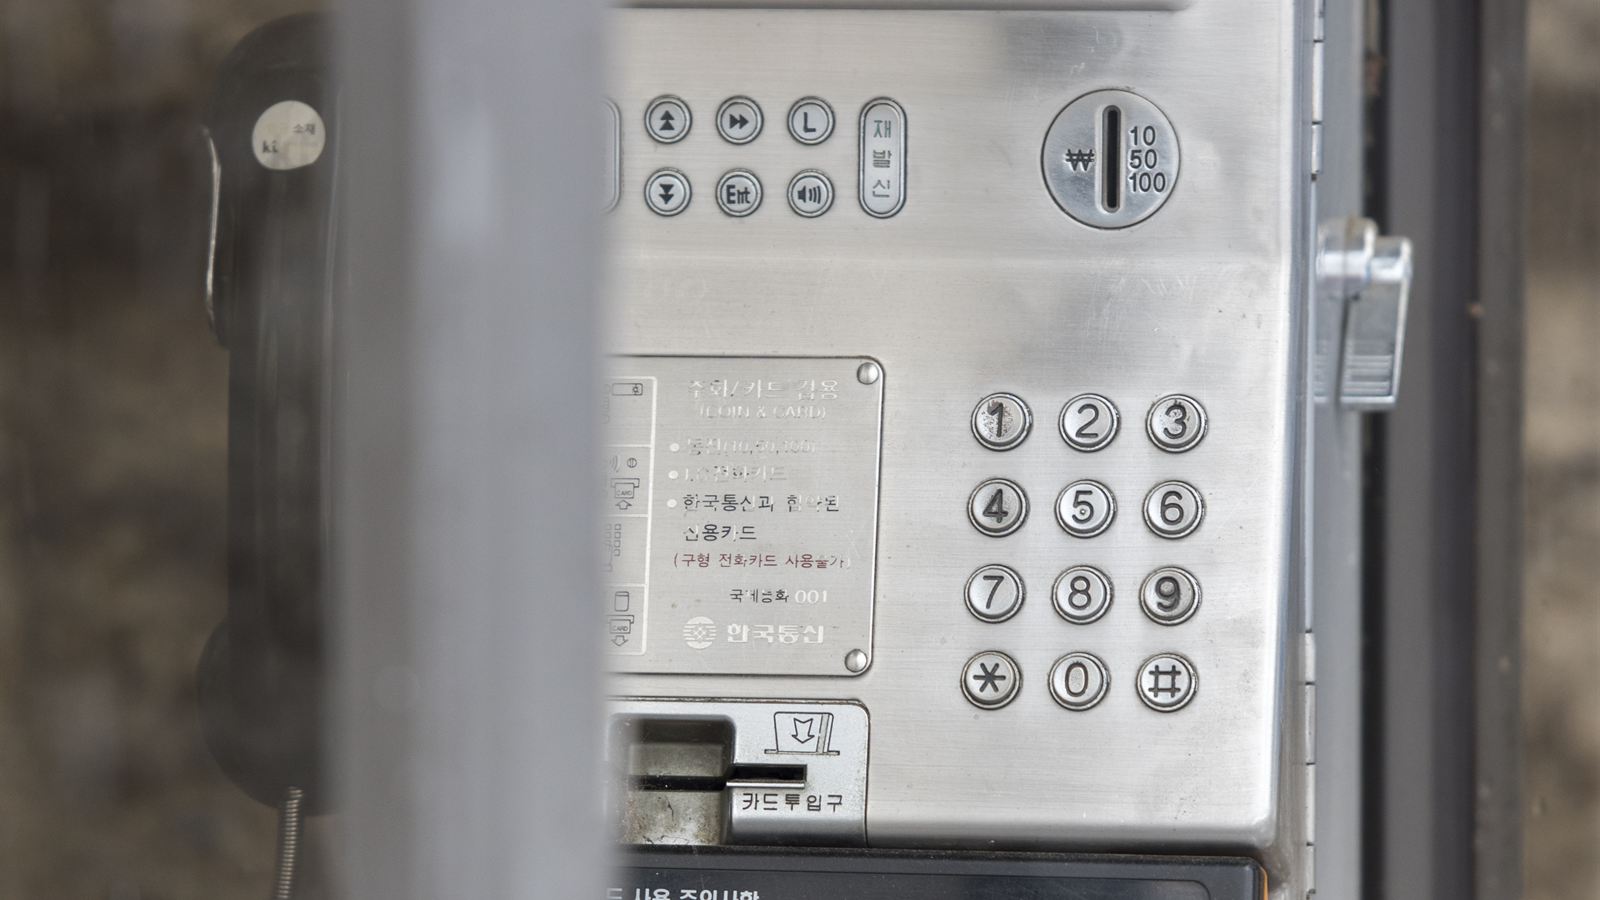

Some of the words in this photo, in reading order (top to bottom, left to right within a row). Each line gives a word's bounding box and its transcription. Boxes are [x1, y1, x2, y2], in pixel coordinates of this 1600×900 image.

[803, 112, 817, 133] L
[1129, 125, 1156, 146] 10
[872, 119, 893, 199] 재발신
[1129, 149, 1157, 169] 50
[1129, 172, 1166, 193] 100
[988, 400, 1004, 437] 1
[1075, 403, 1099, 438] 2
[1163, 403, 1188, 439] 3
[982, 488, 1008, 524] 4
[1071, 490, 1095, 524] 5
[1160, 491, 1184, 525] 6
[719, 553, 778, 568] 전화카드
[795, 589, 828, 604] 001
[983, 575, 1005, 609] 7
[1068, 576, 1091, 610] 8
[1154, 576, 1181, 612] 9
[727, 623, 825, 645] 한국통신
[1065, 661, 1089, 697] 0
[741, 792, 843, 813] 카드투입구
